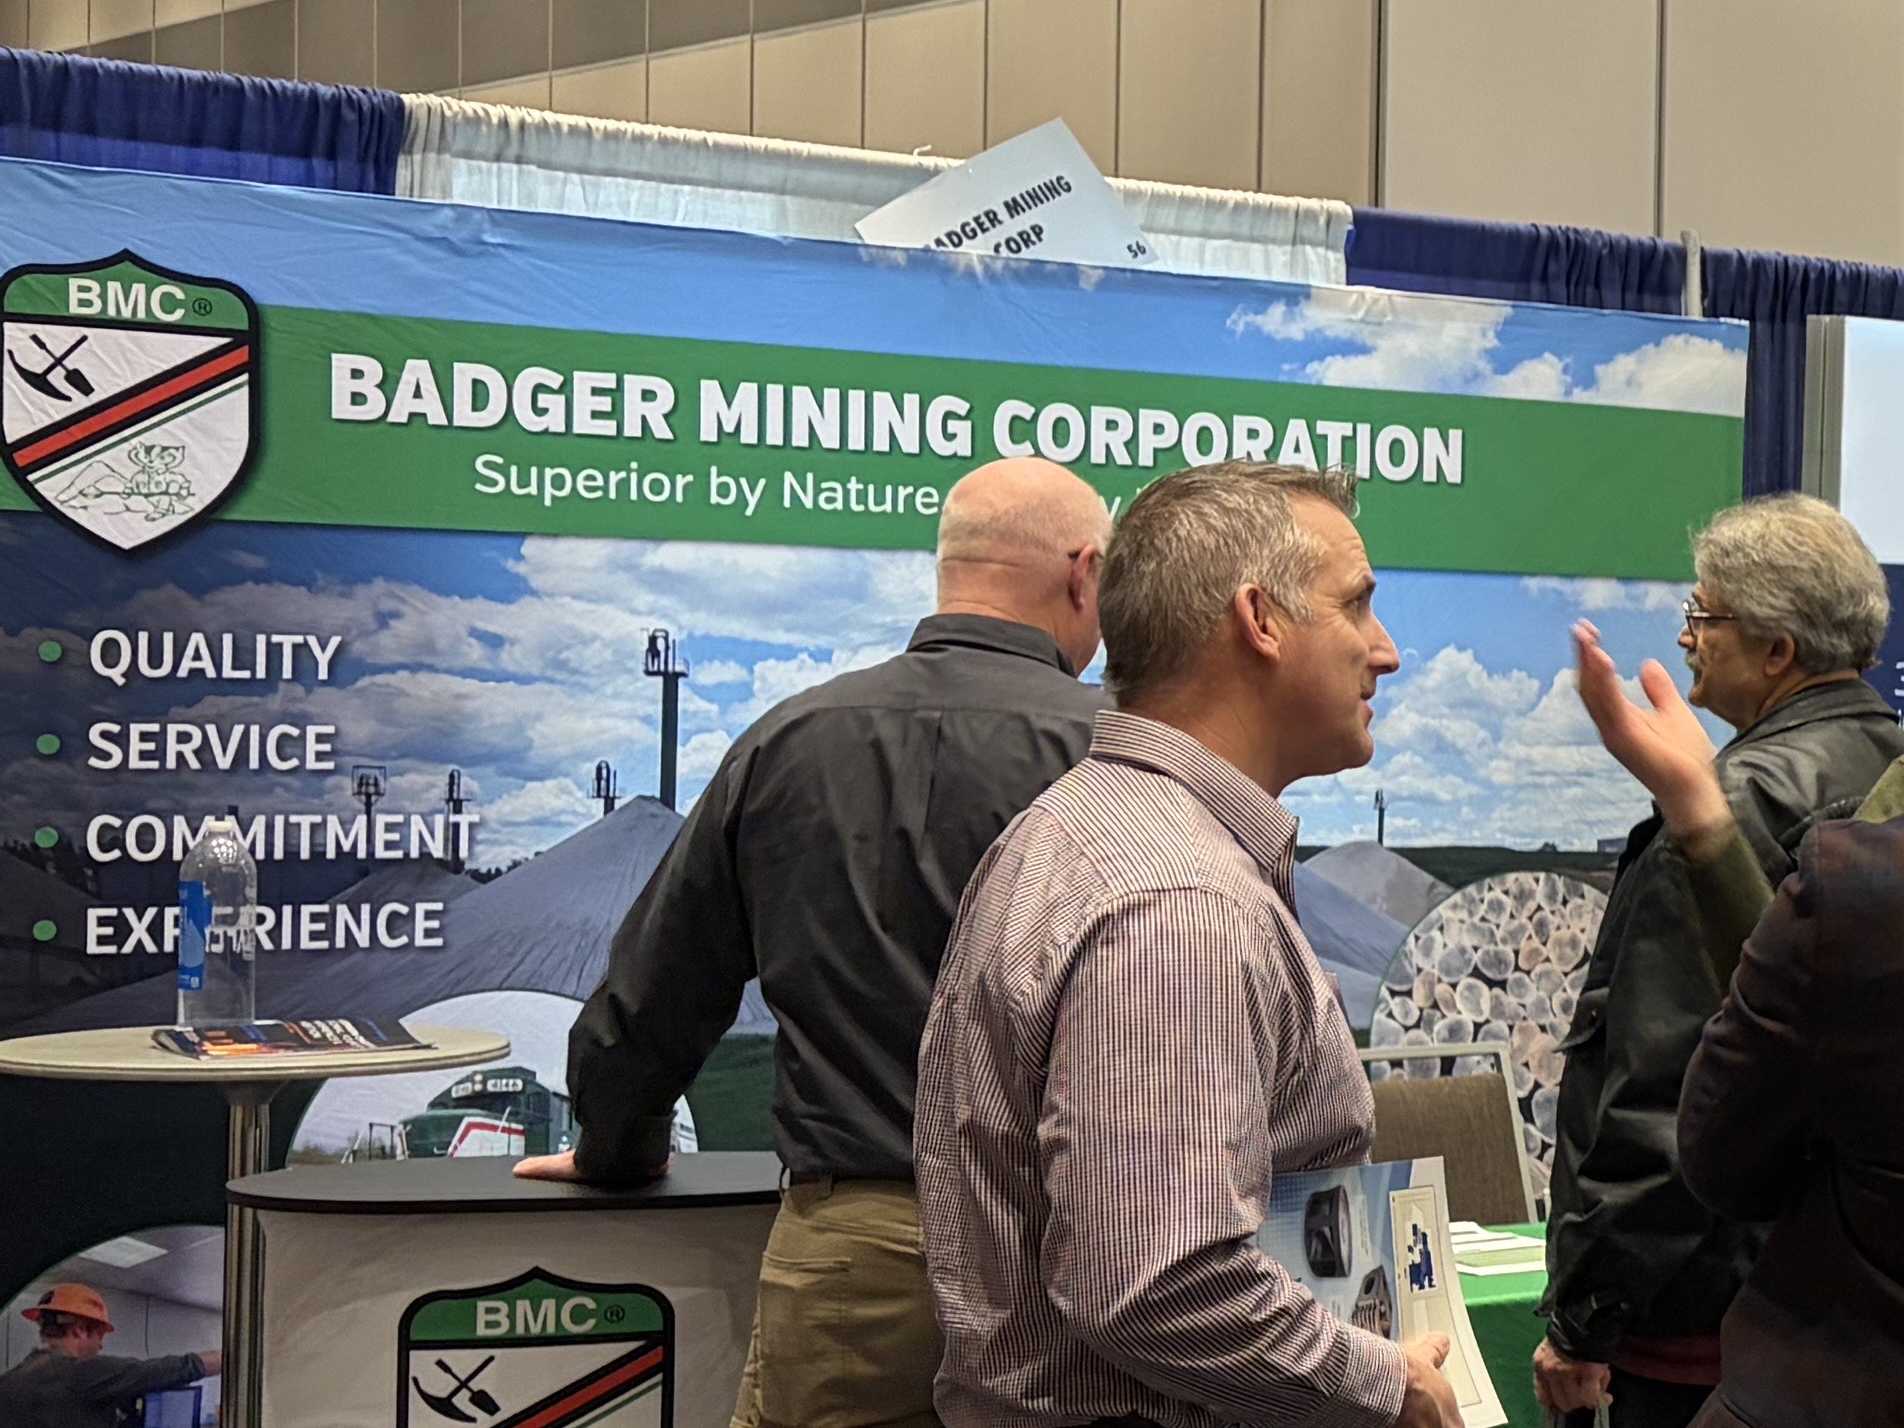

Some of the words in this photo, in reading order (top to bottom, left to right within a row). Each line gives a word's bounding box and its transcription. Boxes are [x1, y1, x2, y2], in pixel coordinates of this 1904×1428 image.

[931, 208, 1003, 251] ADGER
[1003, 174, 1072, 220] MINING
[1127, 240, 1147, 259] 56
[68, 277, 186, 321] BMC
[331, 352, 675, 440] BADGER
[700, 379, 973, 458] MINING
[993, 399, 1463, 484] CORPORATION
[474, 453, 694, 506] Superior
[710, 466, 766, 516] by
[89, 628, 342, 688] QUALITY
[87, 722, 336, 771] SERVICE
[85, 813, 480, 863] COMMITMENT
[476, 1296, 597, 1337] BMC
